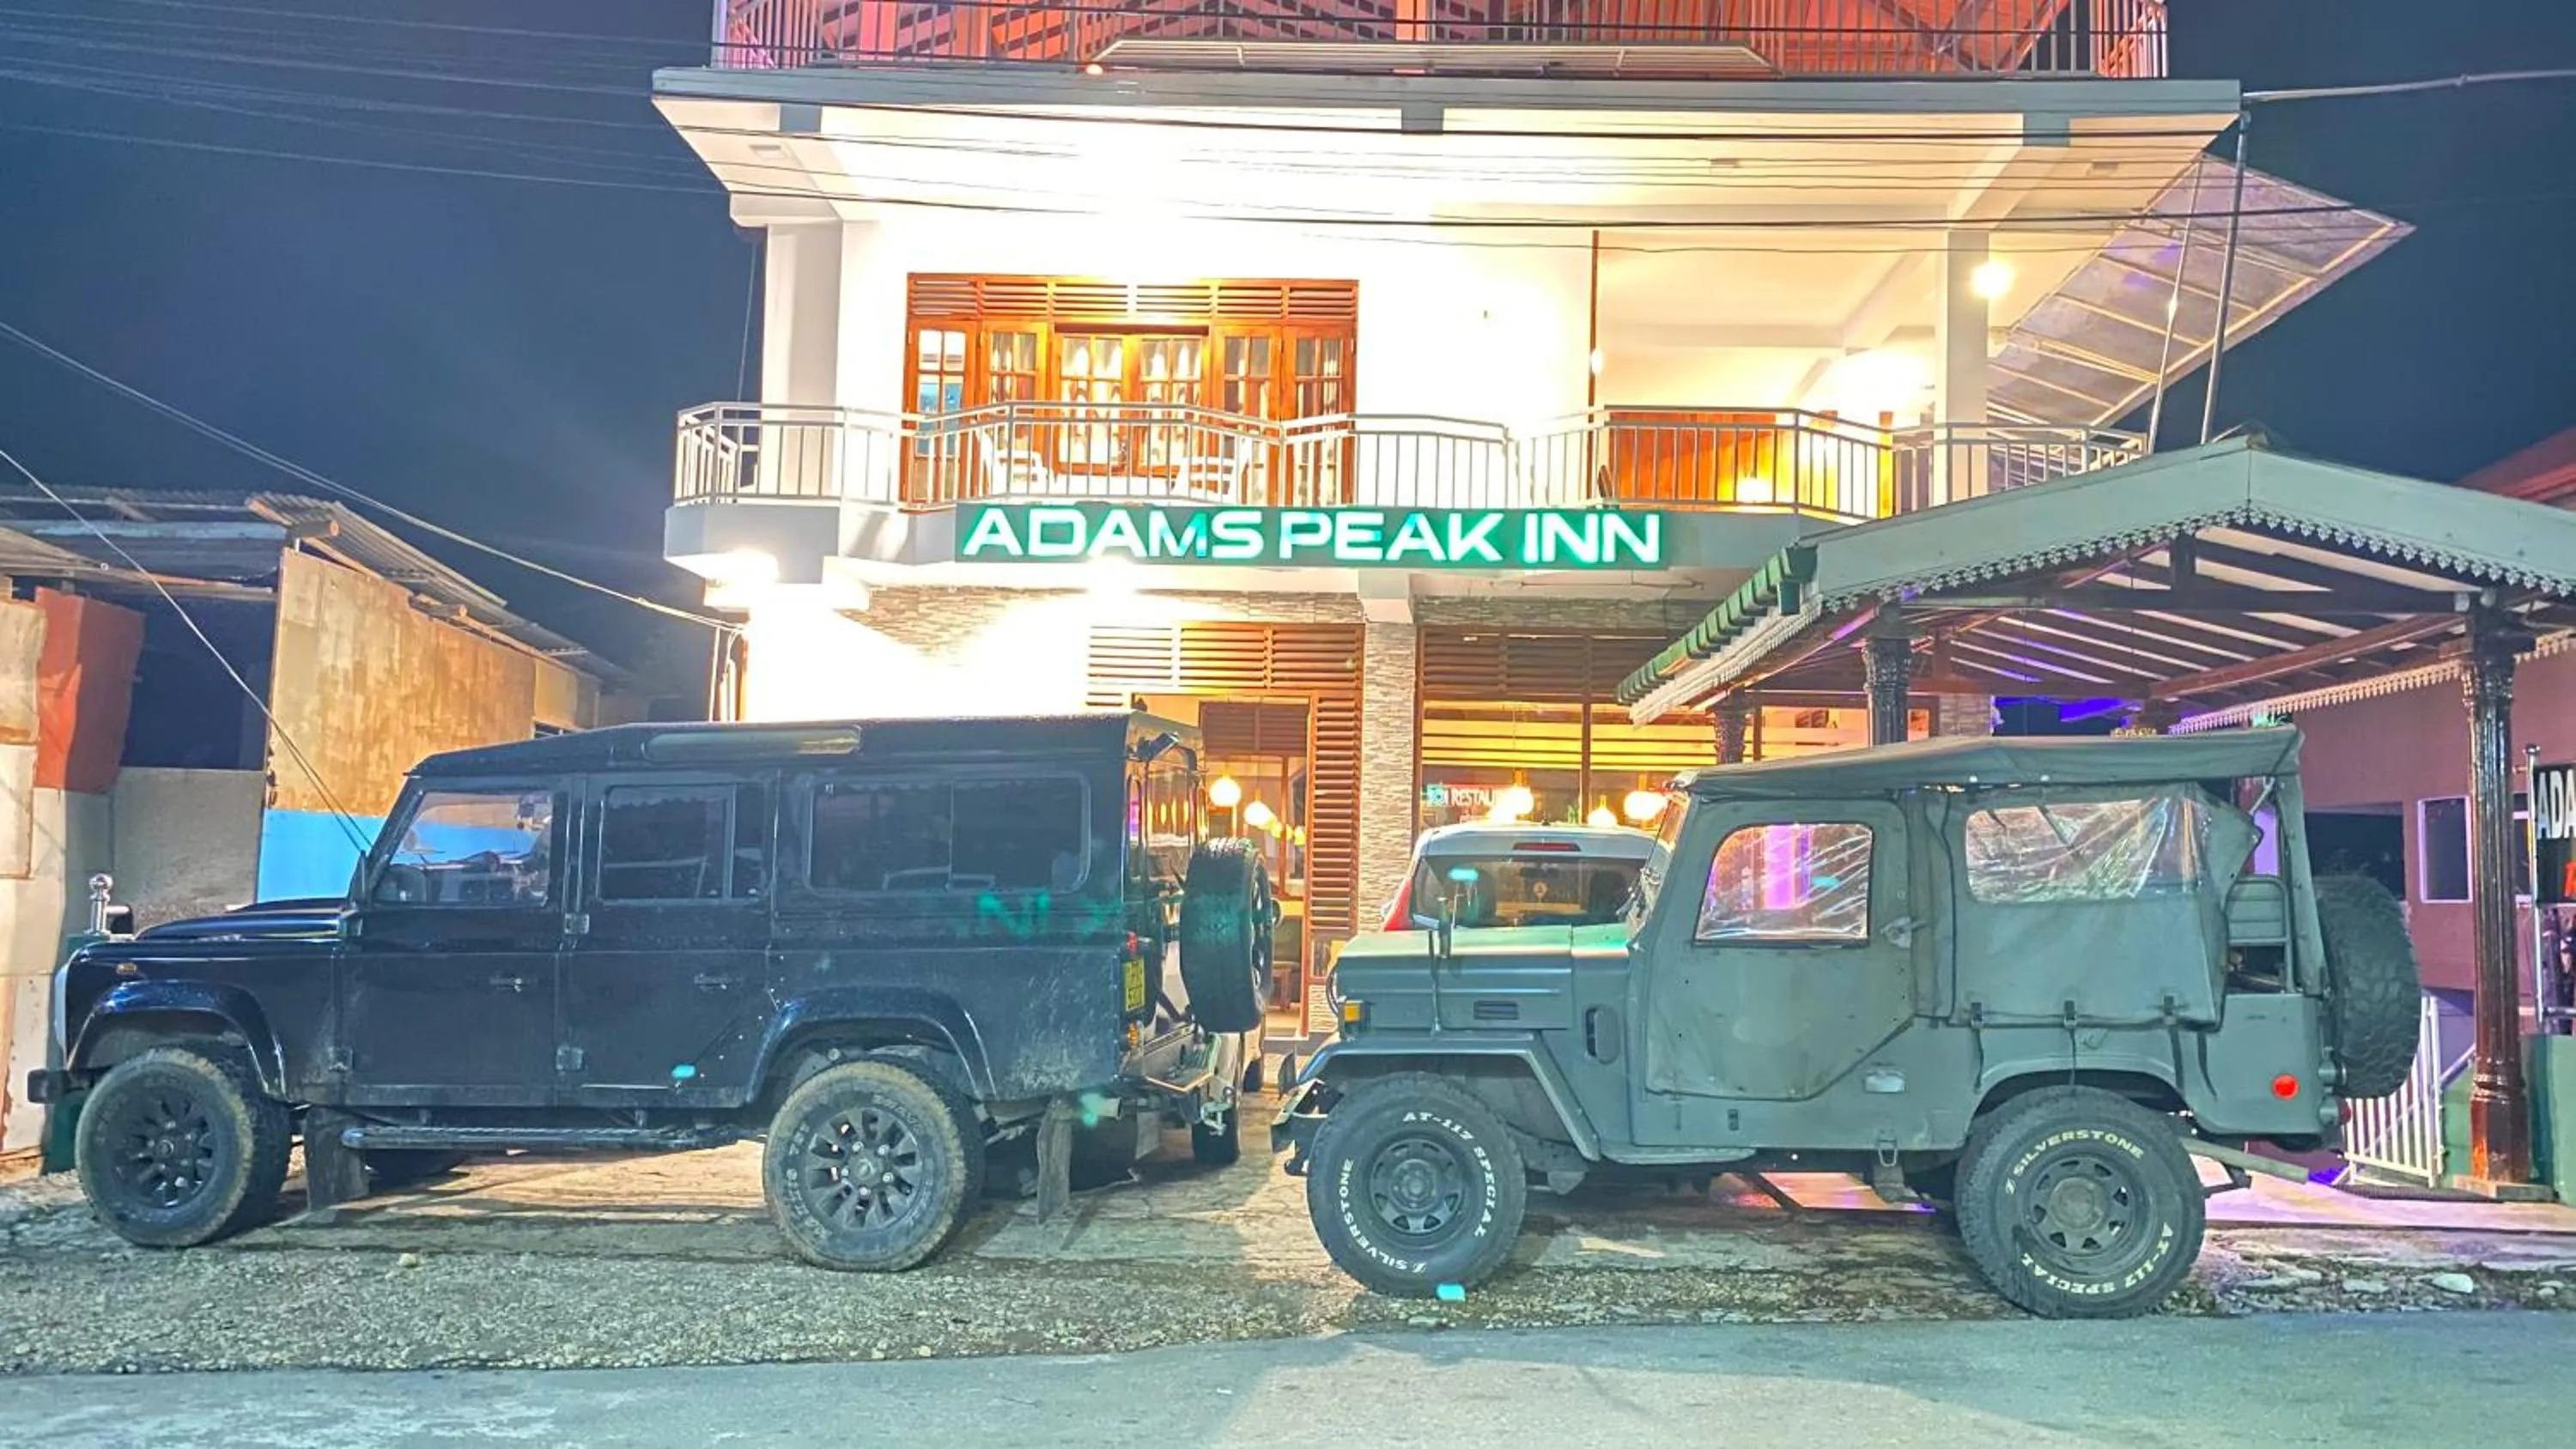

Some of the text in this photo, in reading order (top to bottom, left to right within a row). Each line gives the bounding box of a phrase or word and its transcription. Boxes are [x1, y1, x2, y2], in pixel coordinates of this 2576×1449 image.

[963, 507, 1660, 563] ADAMS PEAK INN
[1403, 1112, 1497, 1237] AT-117 SPECIAL
[2013, 1130, 2144, 1176] SILVERSTONE
[1339, 1158, 1407, 1270] SILVERSTONE
[2020, 1222, 2173, 1294] AT-117 SPECIAL
